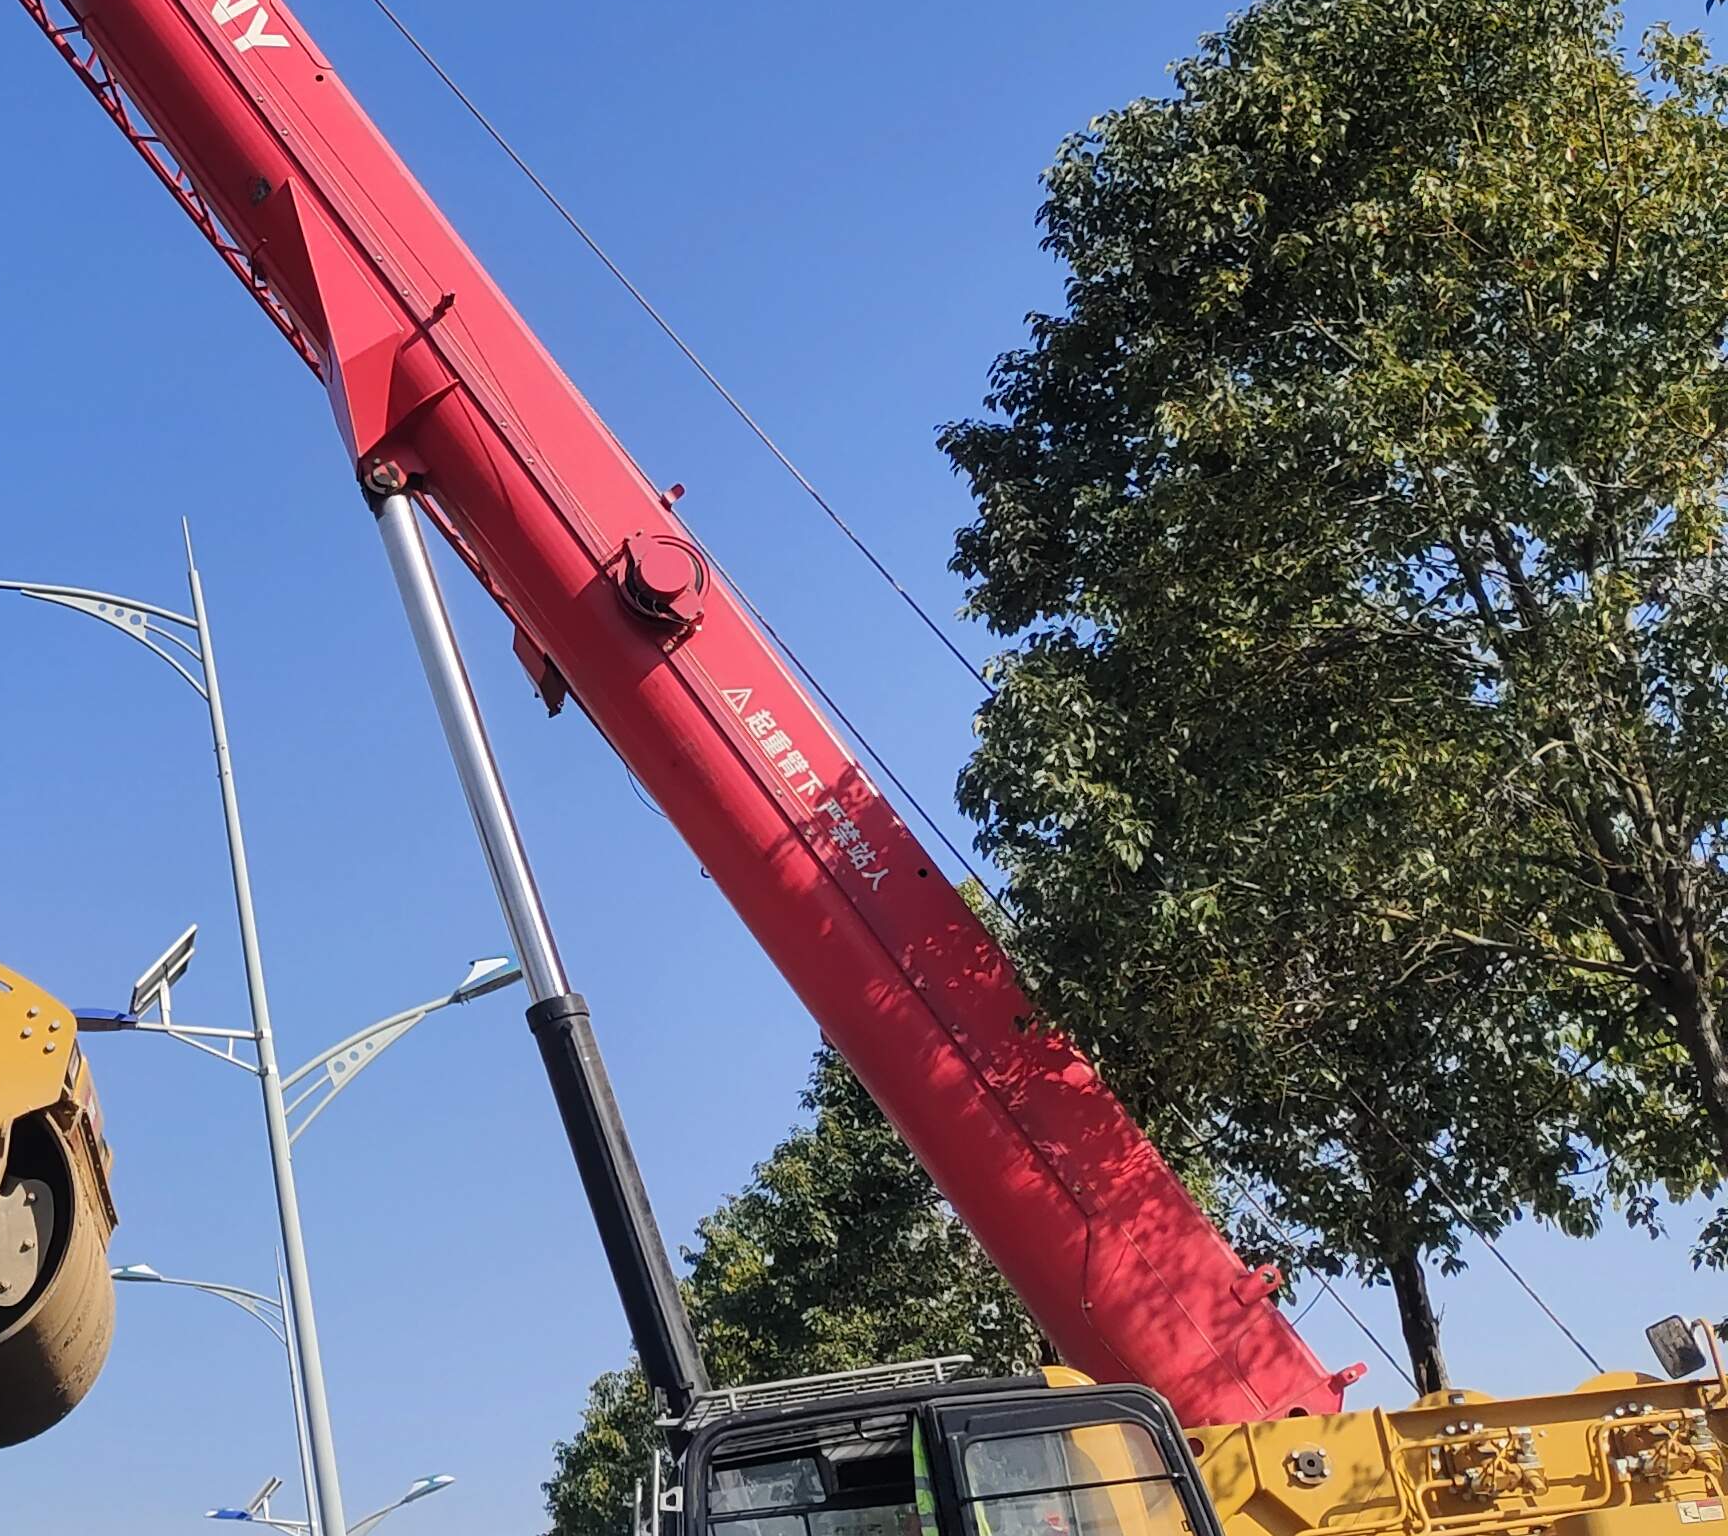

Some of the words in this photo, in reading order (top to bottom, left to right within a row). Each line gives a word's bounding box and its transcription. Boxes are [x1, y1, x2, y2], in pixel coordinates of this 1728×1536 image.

[744, 708, 825, 796] 起重臂下
[814, 796, 889, 891] 严禁站人
